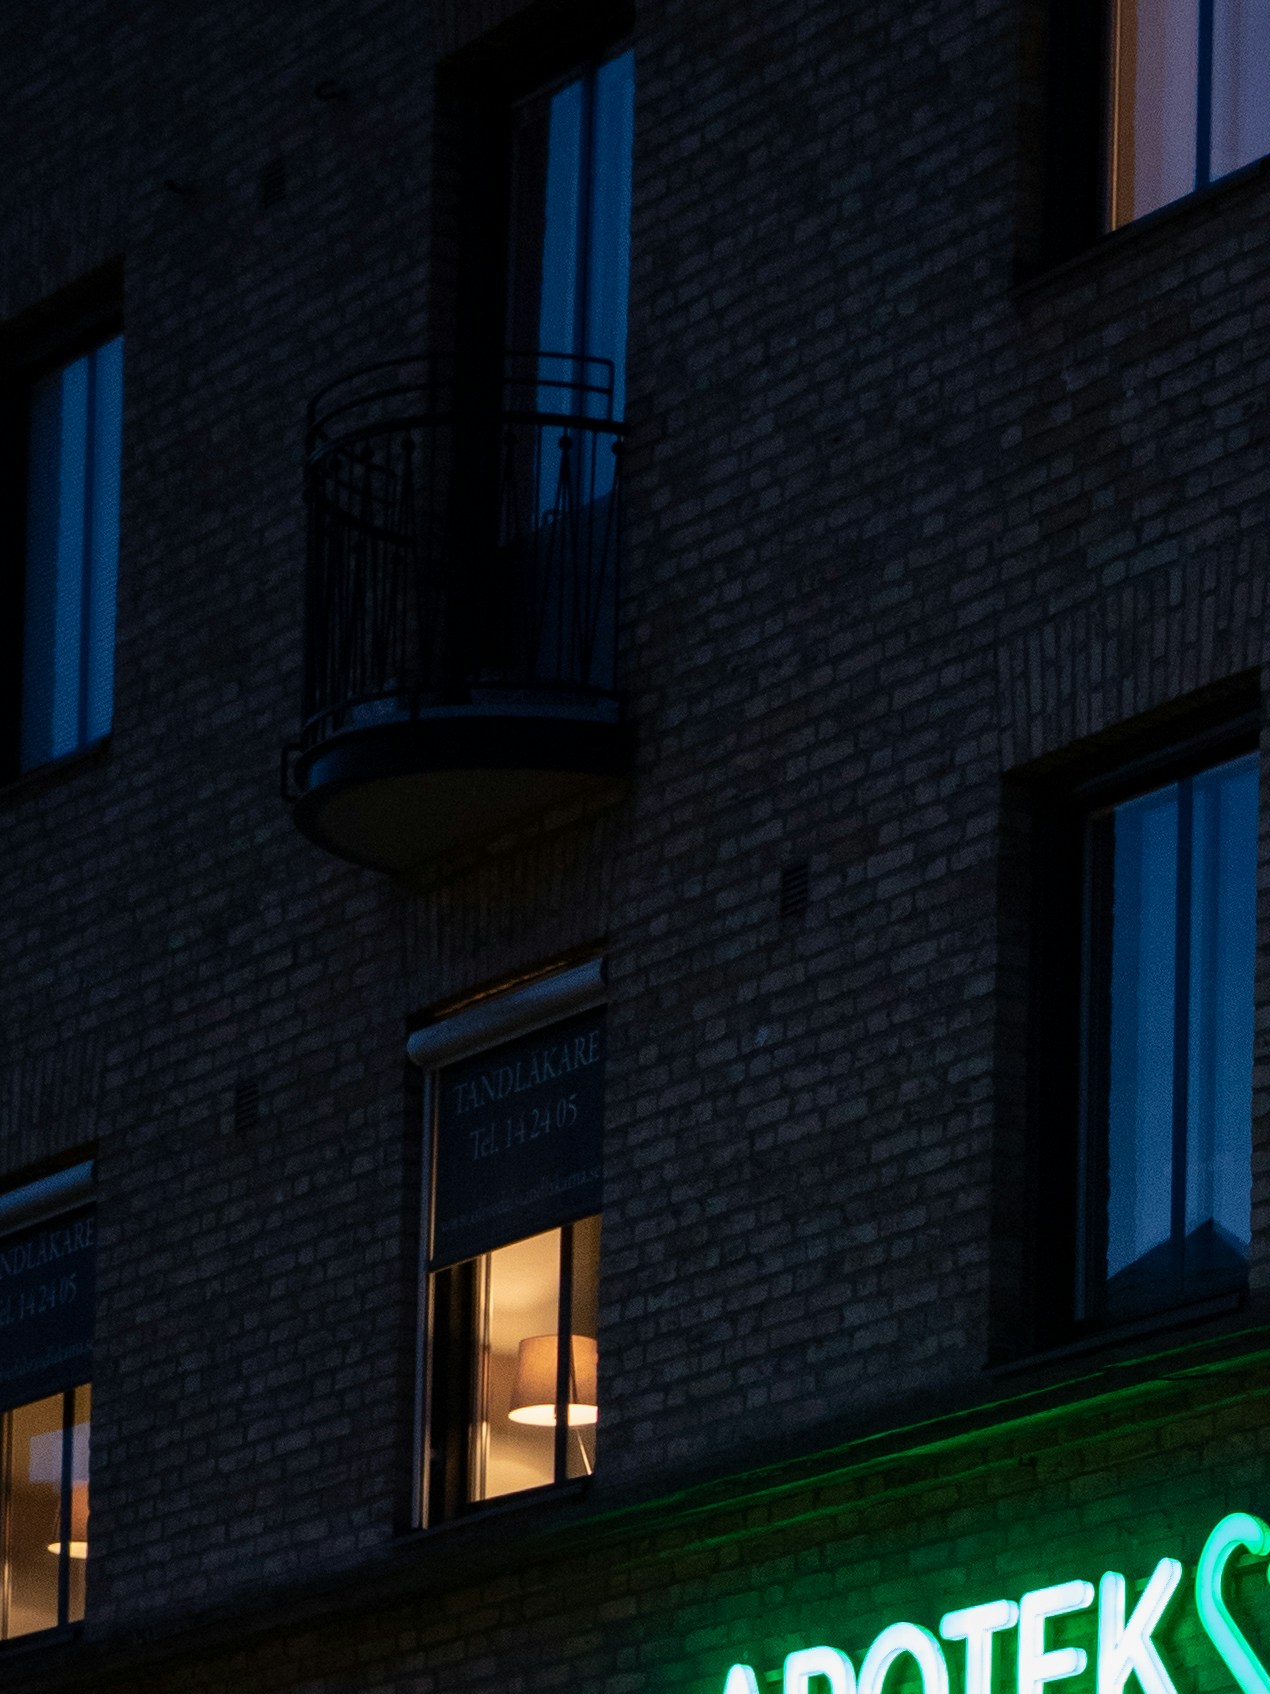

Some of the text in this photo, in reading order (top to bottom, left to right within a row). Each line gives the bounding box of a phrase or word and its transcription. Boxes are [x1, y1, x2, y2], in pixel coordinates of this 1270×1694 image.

[453, 1029, 601, 1115] TANDLÄKARE
[529, 1102, 551, 1140] 24
[556, 1092, 579, 1130] 05
